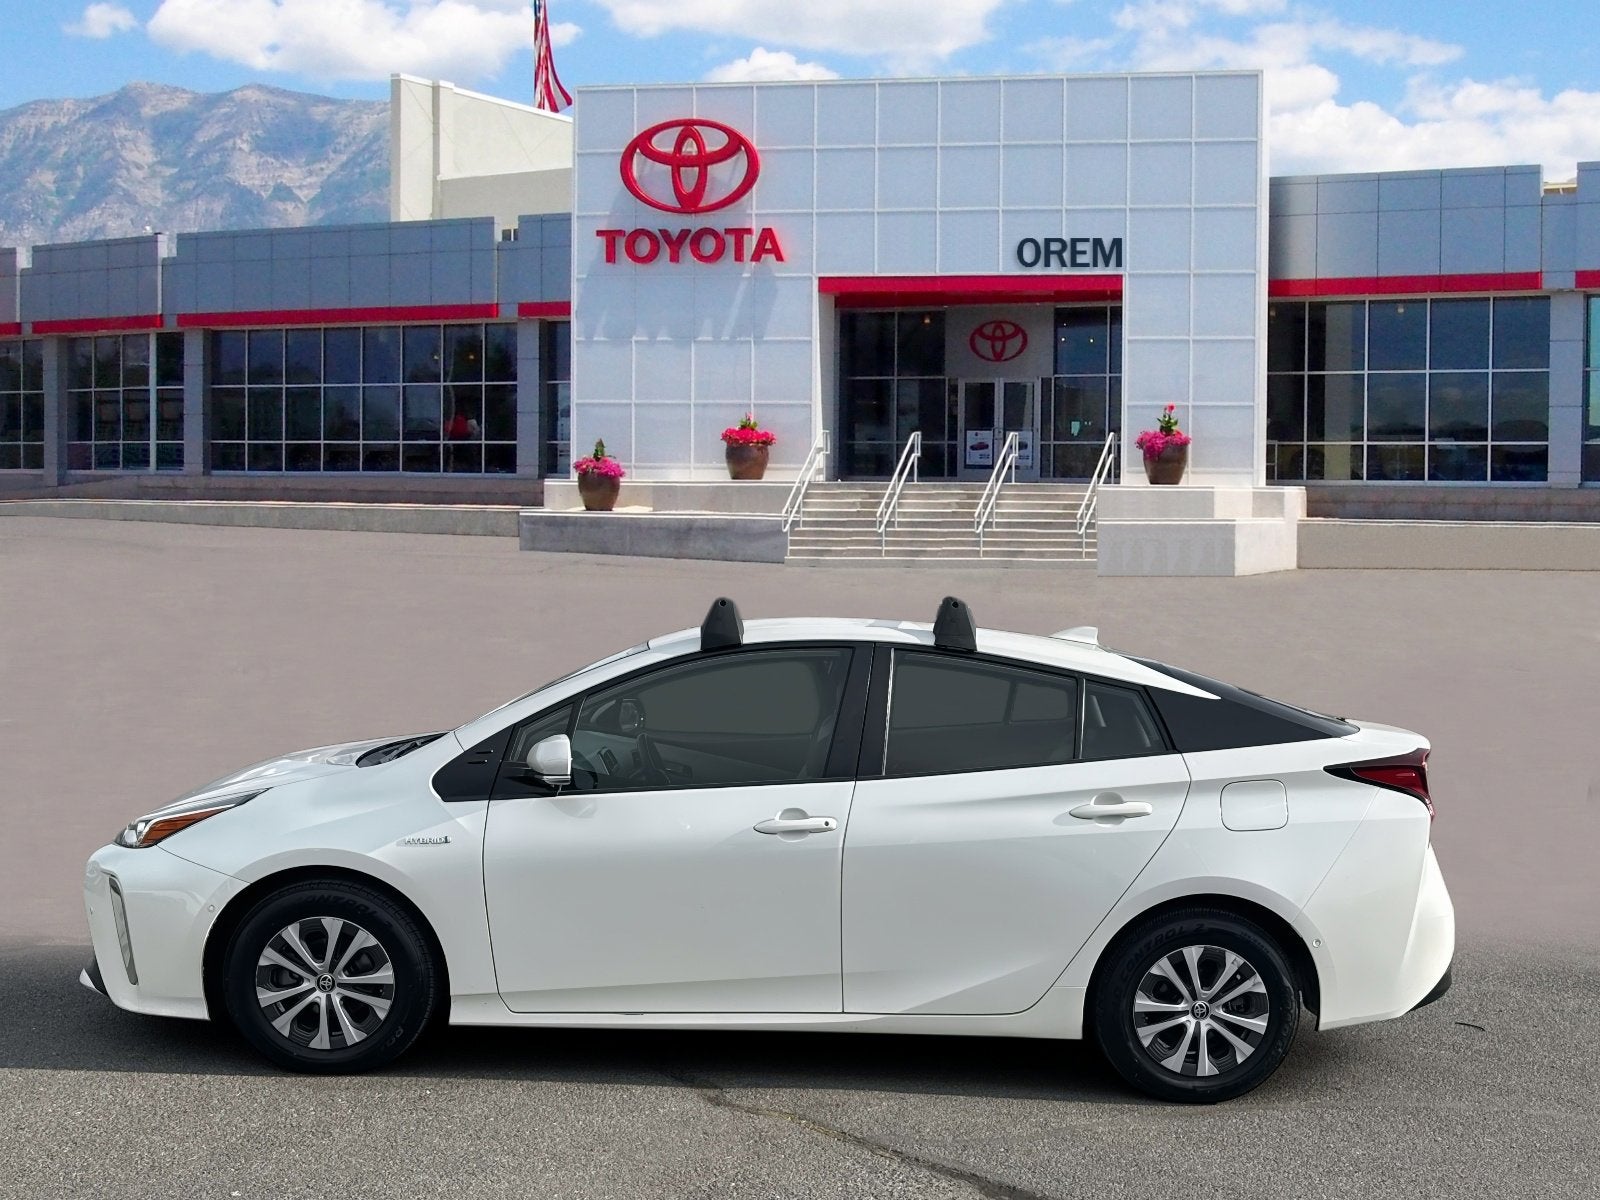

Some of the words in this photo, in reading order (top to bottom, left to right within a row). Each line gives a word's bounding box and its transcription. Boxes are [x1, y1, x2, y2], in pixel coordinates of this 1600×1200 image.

[596, 227, 785, 264] TOYOTA
[1017, 238, 1122, 267] OREM
[404, 836, 450, 845] HYBRID
